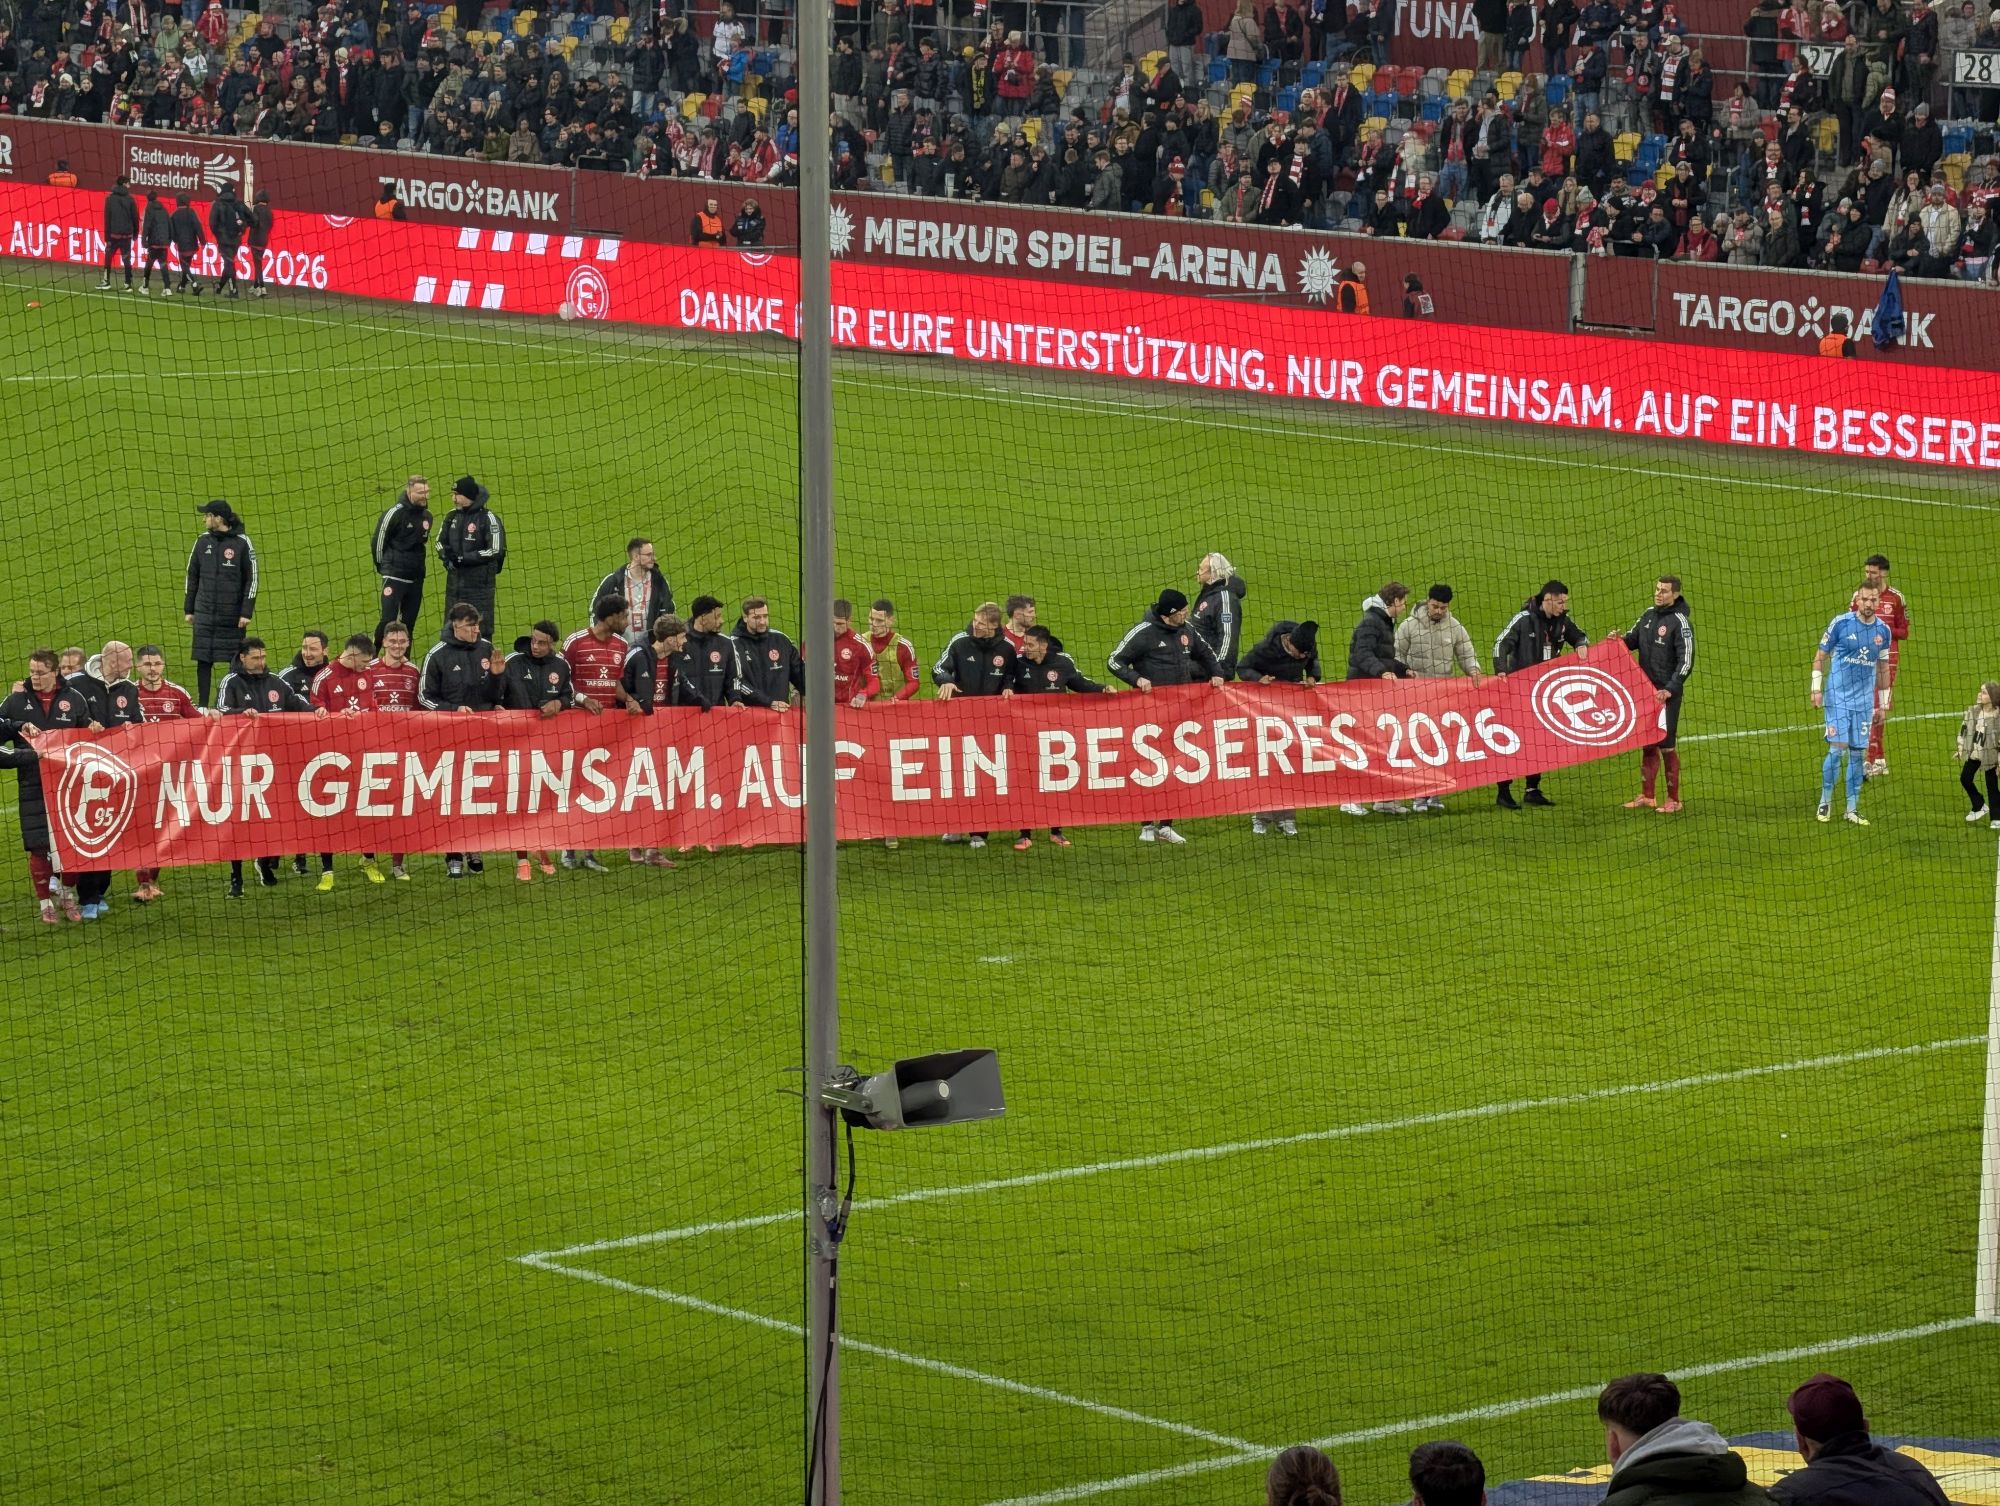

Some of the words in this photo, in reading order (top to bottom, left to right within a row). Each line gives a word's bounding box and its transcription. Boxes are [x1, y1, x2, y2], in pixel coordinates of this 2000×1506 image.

[1810, 47, 1836, 75] 27
[1963, 54, 1993, 82] 28
[130, 146, 200, 169] Stadtwerke
[130, 166, 200, 191] Düsseldorf
[9, 220, 62, 258] AUF
[262, 248, 328, 290] 2026
[864, 216, 1018, 265] MERKUR
[1027, 229, 1287, 291] SPIEL-ARENA
[680, 288, 784, 334] DANKE
[868, 308, 954, 355] EURE
[966, 318, 1275, 392] UNTERSTÜTZUNG.
[1287, 354, 1364, 402] NUR
[1376, 364, 1622, 429] GEMEINSAM.
[1634, 390, 1720, 437] AUF
[1730, 398, 1797, 447] EIN
[1813, 406, 2000, 468] BESSERE
[154, 753, 274, 829] NUR
[297, 745, 722, 818] GEMEINSAM.
[889, 733, 1008, 801] EIN
[1038, 713, 1369, 793] BESSERES
[1376, 707, 1521, 768] 2026
